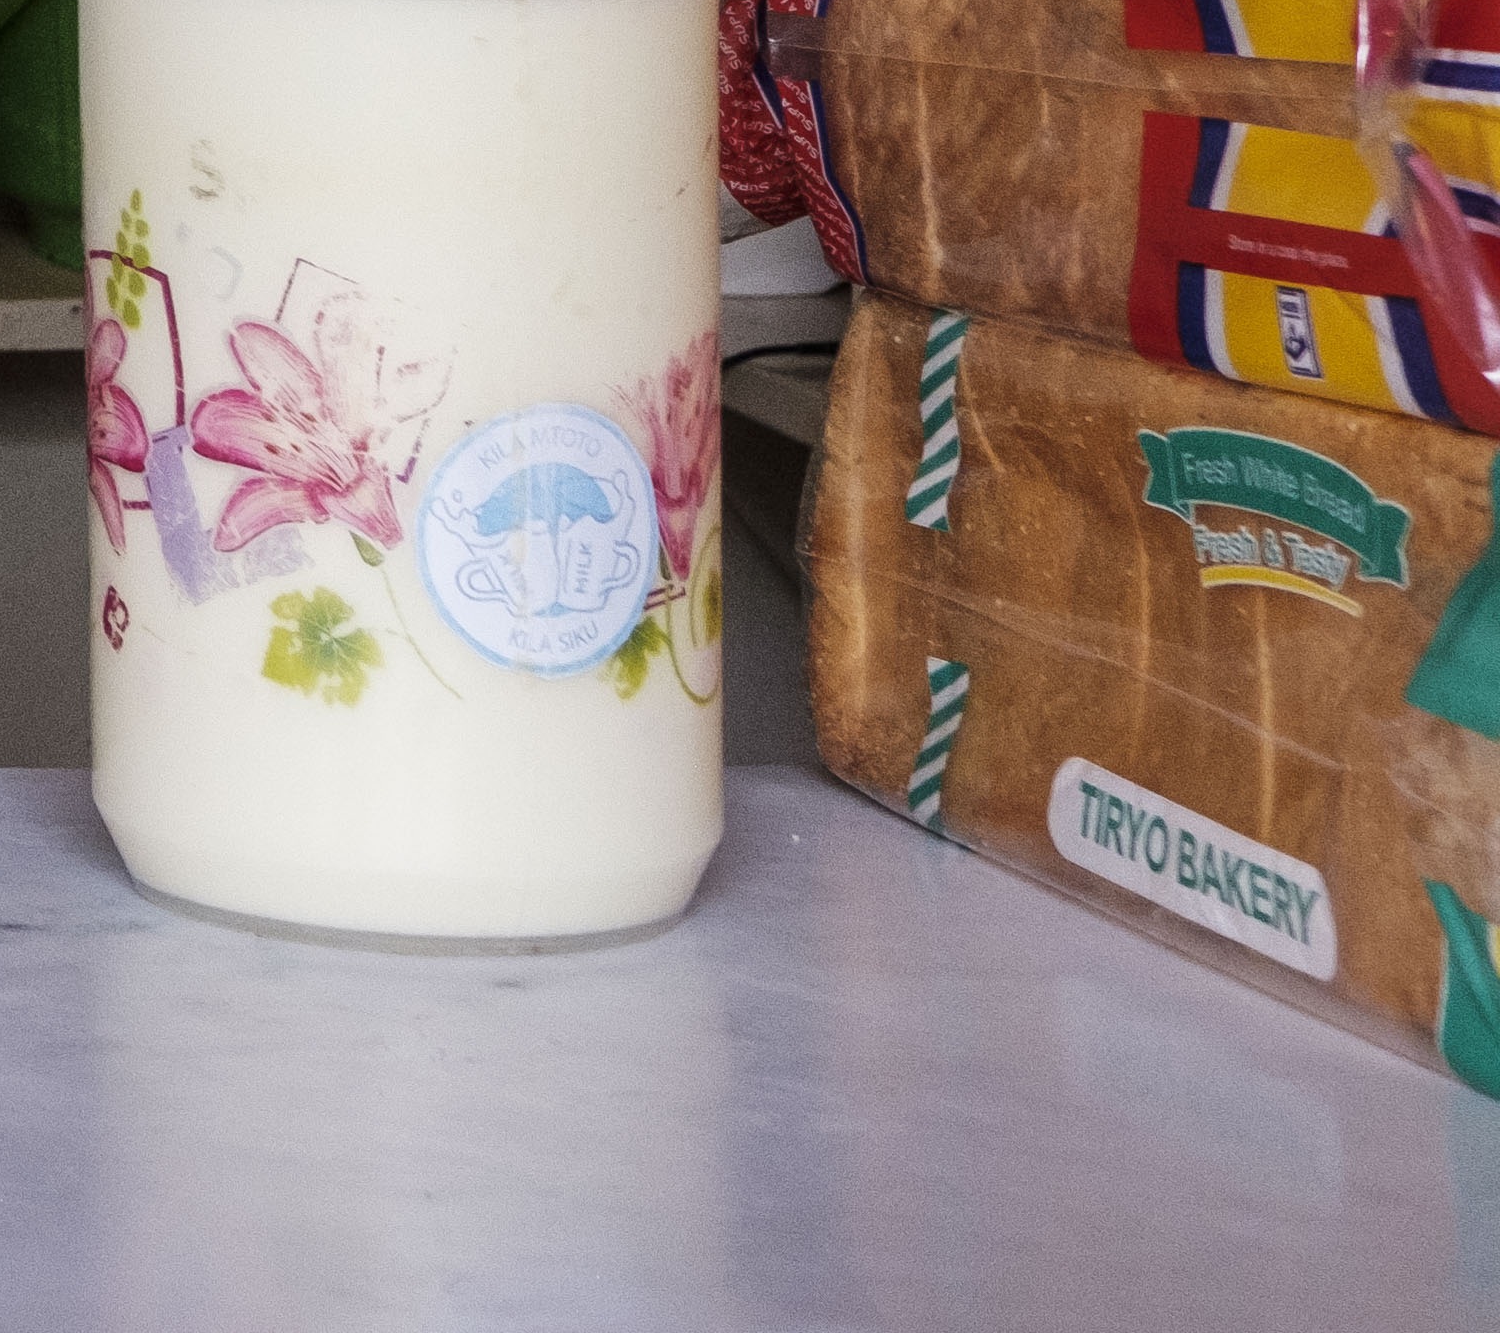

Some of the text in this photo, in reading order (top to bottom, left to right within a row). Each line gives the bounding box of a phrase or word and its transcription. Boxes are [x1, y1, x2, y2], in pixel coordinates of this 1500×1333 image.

[530, 425, 602, 459] MTOTO
[1181, 451, 1367, 535] Fresh White Bread
[574, 542, 594, 595] MILK
[1191, 523, 1353, 590] Fresh & Tasty
[558, 620, 601, 654] SIKU
[1079, 779, 1322, 948] TIRYO BAKERY
